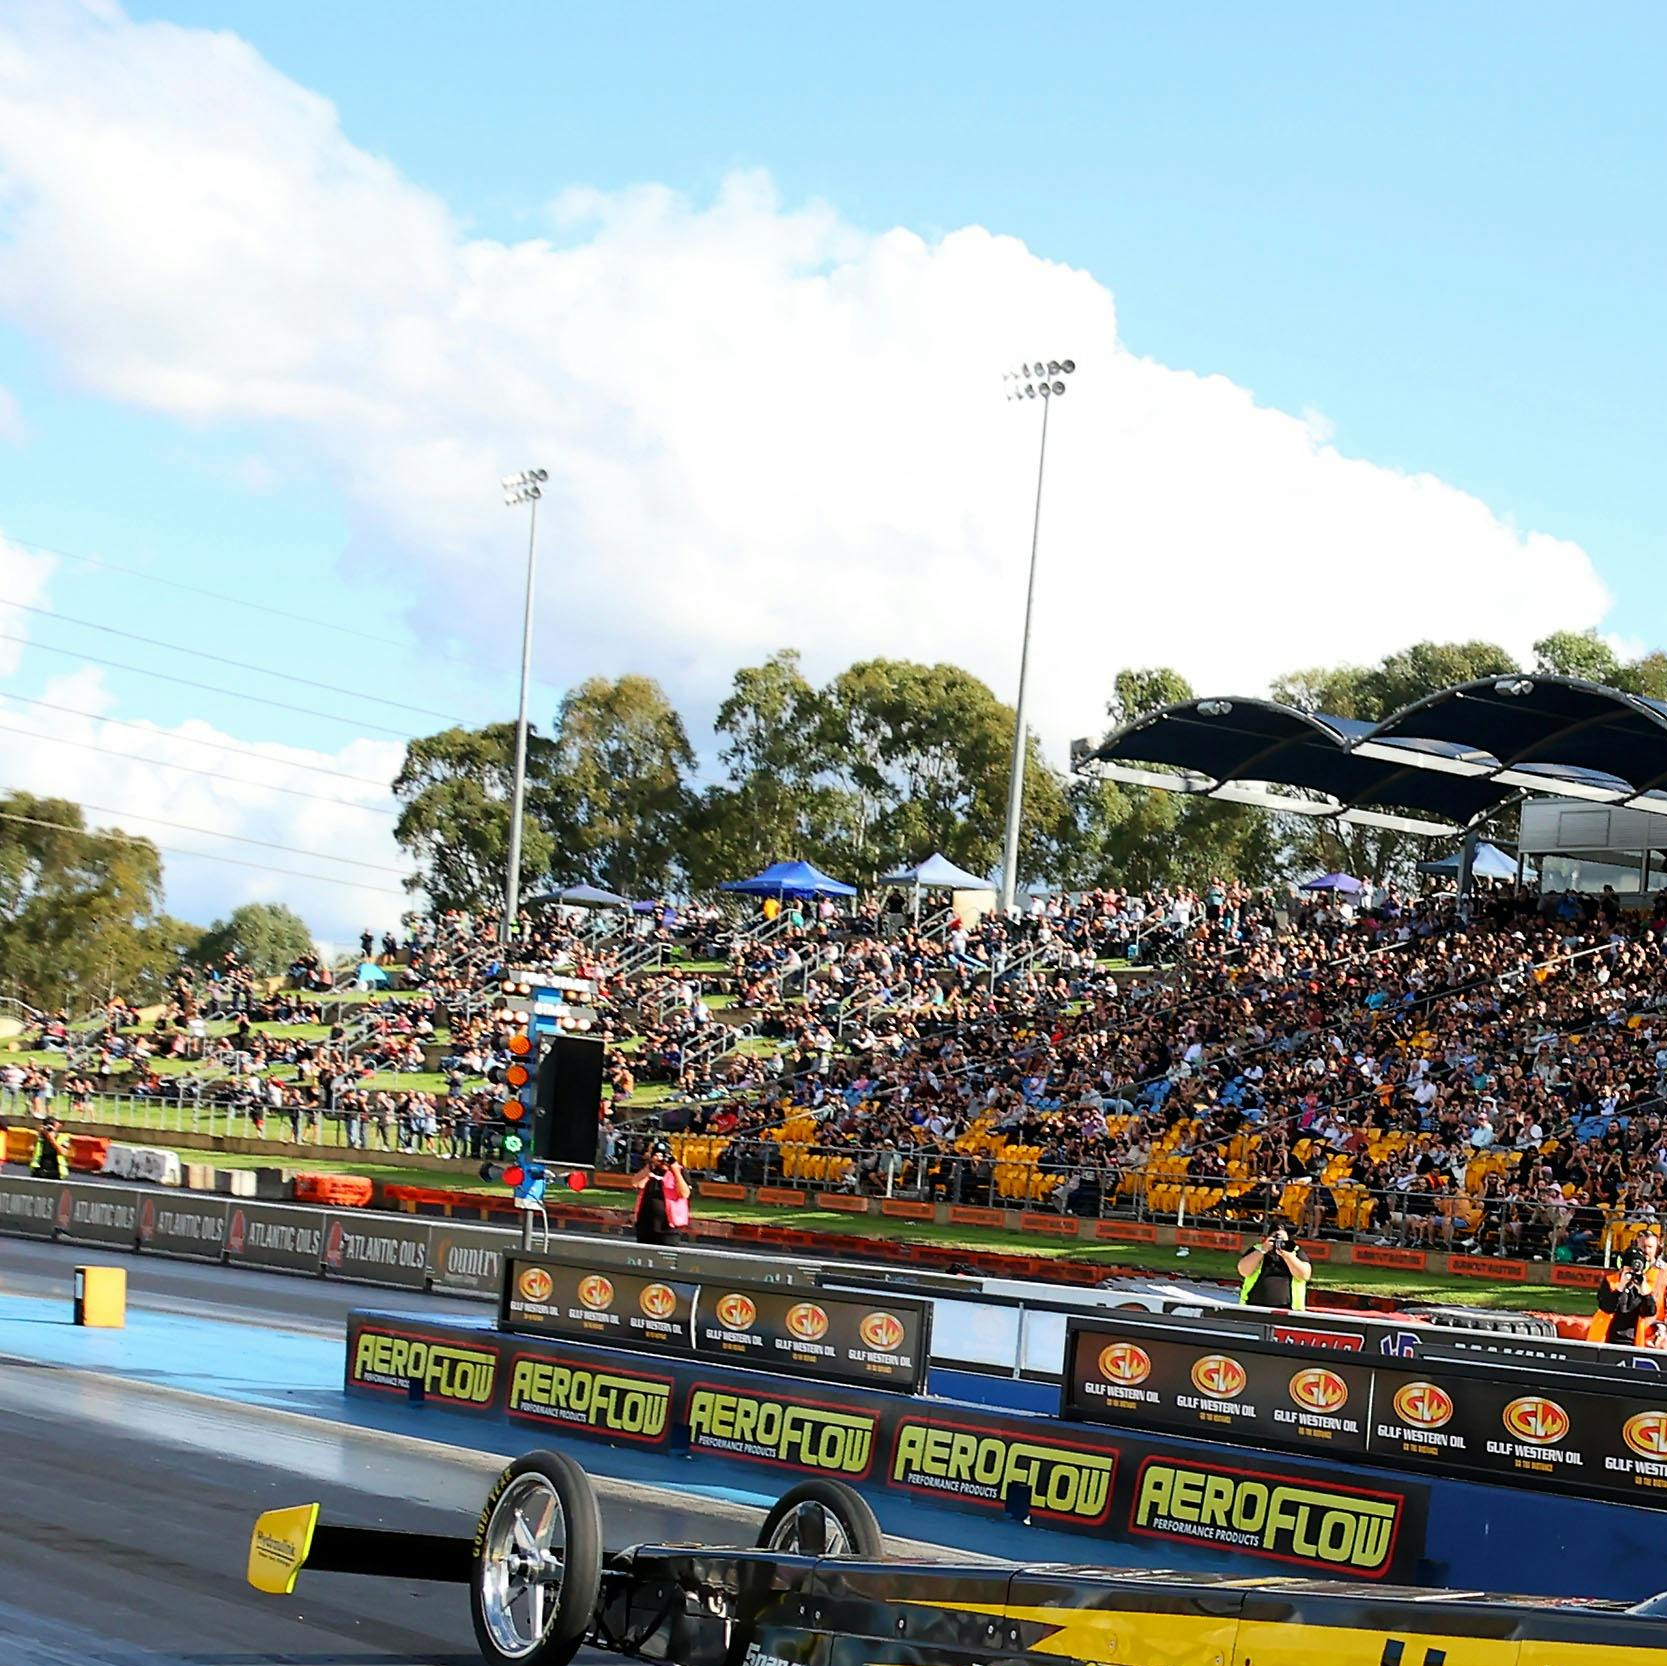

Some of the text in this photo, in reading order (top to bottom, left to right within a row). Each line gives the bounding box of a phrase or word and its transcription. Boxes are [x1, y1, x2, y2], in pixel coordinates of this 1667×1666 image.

[75, 1200, 114, 1227] ATLANTIC
[158, 1211, 225, 1242] ATLANTIC OILS
[249, 1222, 322, 1256] ATLANTIC OILS
[345, 1232, 427, 1269] ATLANTIC OILS
[775, 1338, 836, 1357] GULF WESTERN OIL
[848, 1349, 912, 1368] GULF WESTERN OIL
[354, 1332, 496, 1403] AEROFLOW
[510, 1360, 671, 1436] AEROFLOW
[1085, 1382, 1106, 1395] GULF
[1106, 1385, 1145, 1401] WESTERN
[1146, 1391, 1161, 1404] OIL
[1177, 1396, 1199, 1409] GULF
[1200, 1398, 1240, 1415] WESTERN
[1241, 1405, 1257, 1418] OIL
[689, 1390, 875, 1473] AEROFLOW
[1274, 1409, 1298, 1423] GULF
[1298, 1413, 1342, 1431] WESTERN
[1343, 1419, 1359, 1434] OIL
[699, 1434, 777, 1459] PERFORMANCE PRODUCTS
[1378, 1424, 1466, 1449] GULF WESTERN OIL
[1486, 1440, 1513, 1455] GULF
[1514, 1444, 1564, 1463] WESTERN
[1565, 1451, 1584, 1466] OIL
[1604, 1457, 1633, 1472] GULF
[894, 1424, 1113, 1517] AEROFLOW
[907, 1472, 998, 1499] PERFORMANCE PRODUCTS
[1137, 1466, 1396, 1568] AEROFLOW
[1152, 1517, 1260, 1548] PERFORMANCE PRODUCTS
